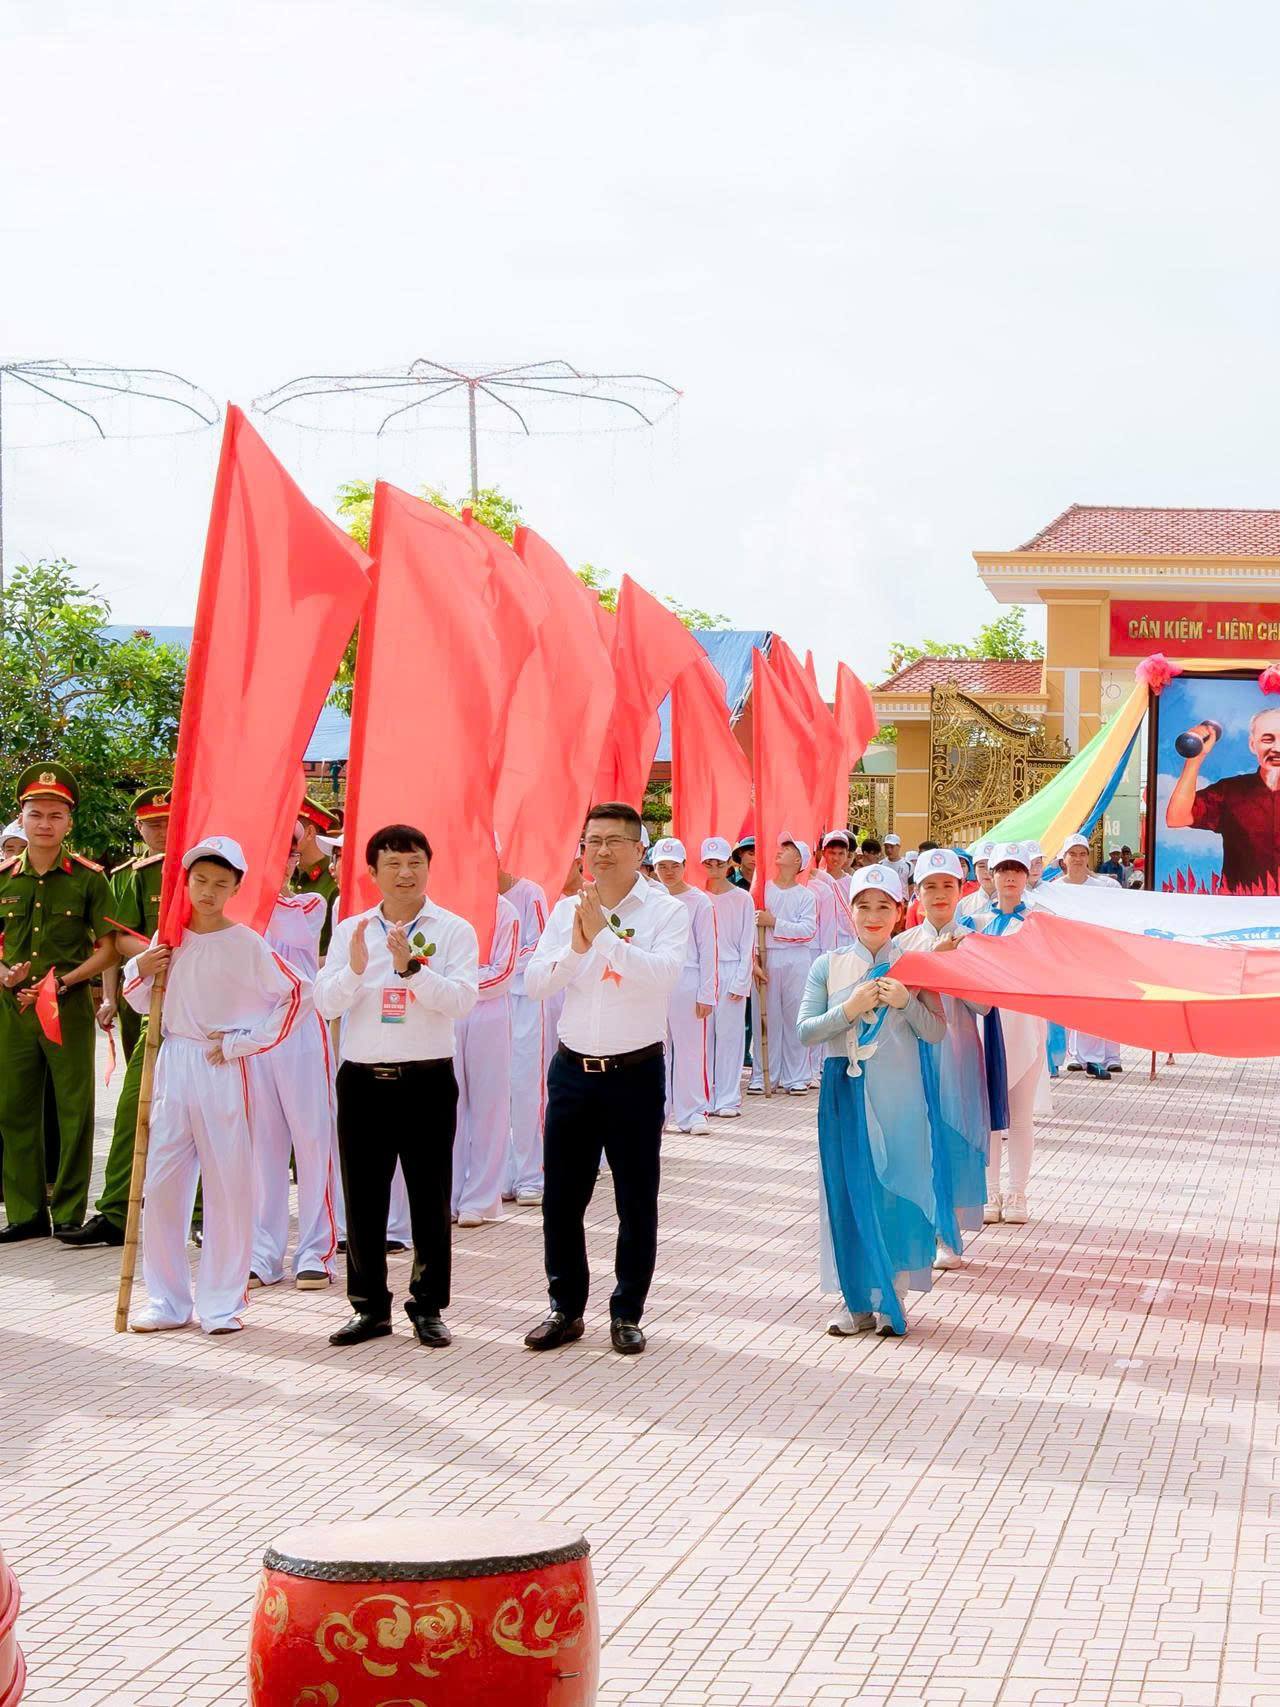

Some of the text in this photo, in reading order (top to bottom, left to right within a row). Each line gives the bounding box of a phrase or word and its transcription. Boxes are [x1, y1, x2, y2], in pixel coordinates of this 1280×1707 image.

[1128, 614, 1161, 639] CẦN
[1164, 617, 1203, 643] KIỆM
[1216, 618, 1254, 640] LIÊM
